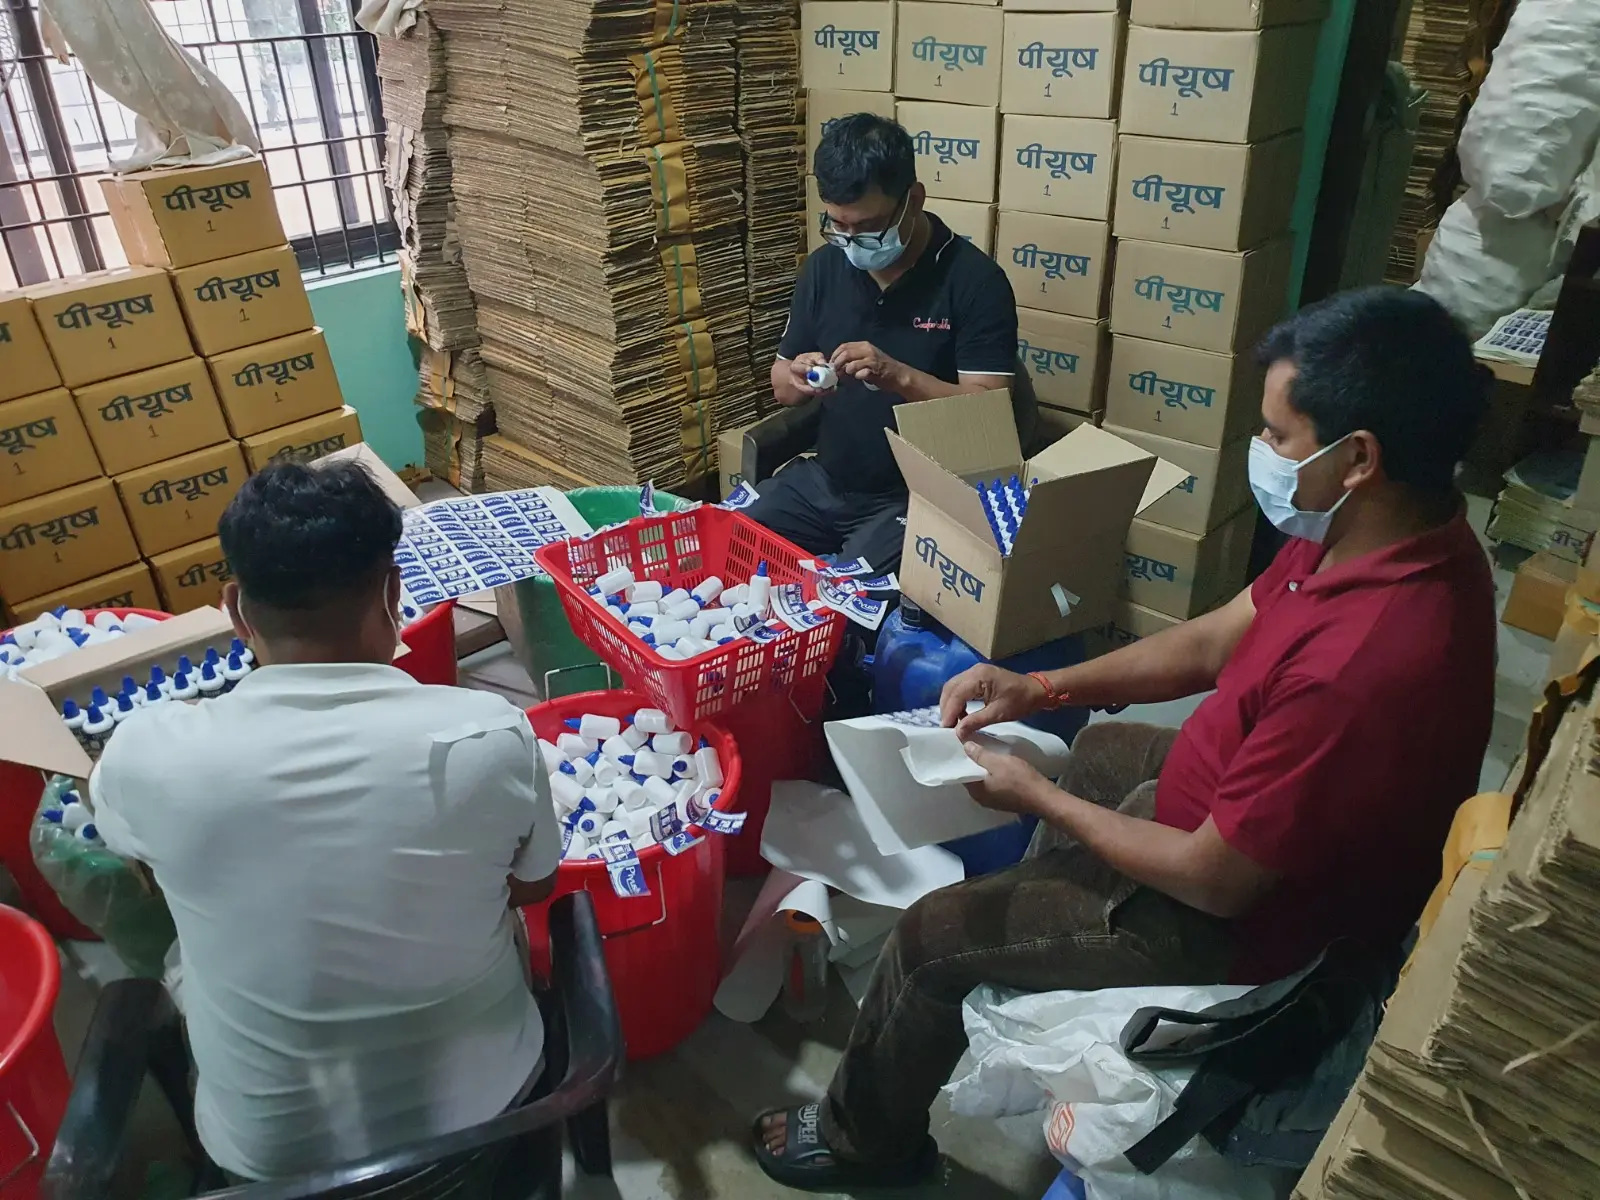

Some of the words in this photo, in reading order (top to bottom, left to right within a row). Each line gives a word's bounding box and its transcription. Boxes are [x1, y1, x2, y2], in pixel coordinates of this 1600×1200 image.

[814, 24, 880, 56] पीयूष
[912, 36, 987, 71] पीयूष
[1018, 42, 1099, 78] पीयूष
[1139, 58, 1234, 98] पीयूष
[1016, 143, 1097, 179] पीयूष
[162, 180, 251, 212] पीयूष
[1132, 175, 1225, 214] पीयूष
[1013, 244, 1091, 280] पीयूष
[194, 269, 280, 303] पीयूष
[1135, 276, 1225, 315] पीयूष
[54, 294, 154, 329] पीयूष
[232, 352, 315, 388] पीयूष
[98, 382, 194, 422] पीयूष
[1129, 371, 1216, 410] पीयूष
[0, 417, 57, 455] यूष
[139, 467, 229, 506] पीयूष
[0, 506, 100, 550] पीयूष
[916, 534, 986, 603] पीयूष
[1125, 552, 1177, 583] यूष
[802, 1104, 819, 1144] SUPER
